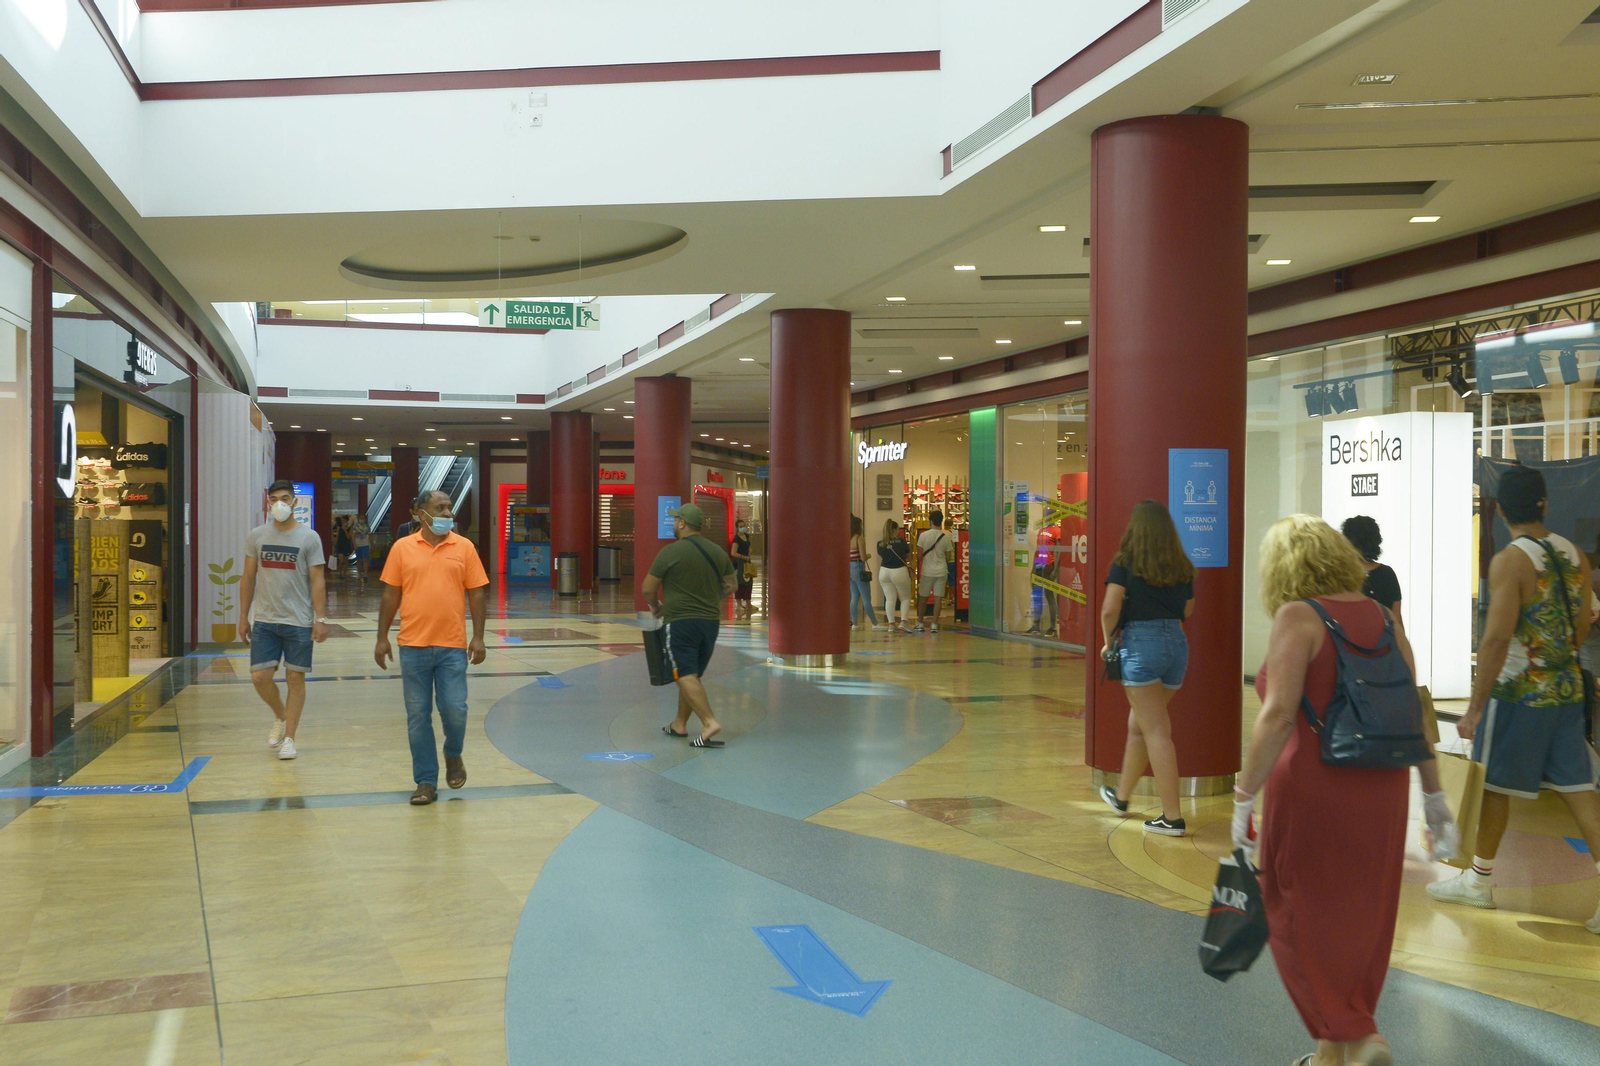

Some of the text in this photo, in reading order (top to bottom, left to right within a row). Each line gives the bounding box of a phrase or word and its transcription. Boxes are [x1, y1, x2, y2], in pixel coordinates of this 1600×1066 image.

[513, 304, 566, 315] SALIDA DE
[506, 315, 572, 326] EMERGENCIA
[1330, 429, 1402, 465] Bershka
[116, 452, 149, 462] adidas
[857, 438, 908, 469] Sprinter
[1352, 476, 1377, 494] STAGE
[1184, 516, 1217, 524] DISTANCIA
[1188, 524, 1214, 532] MÍNIMA
